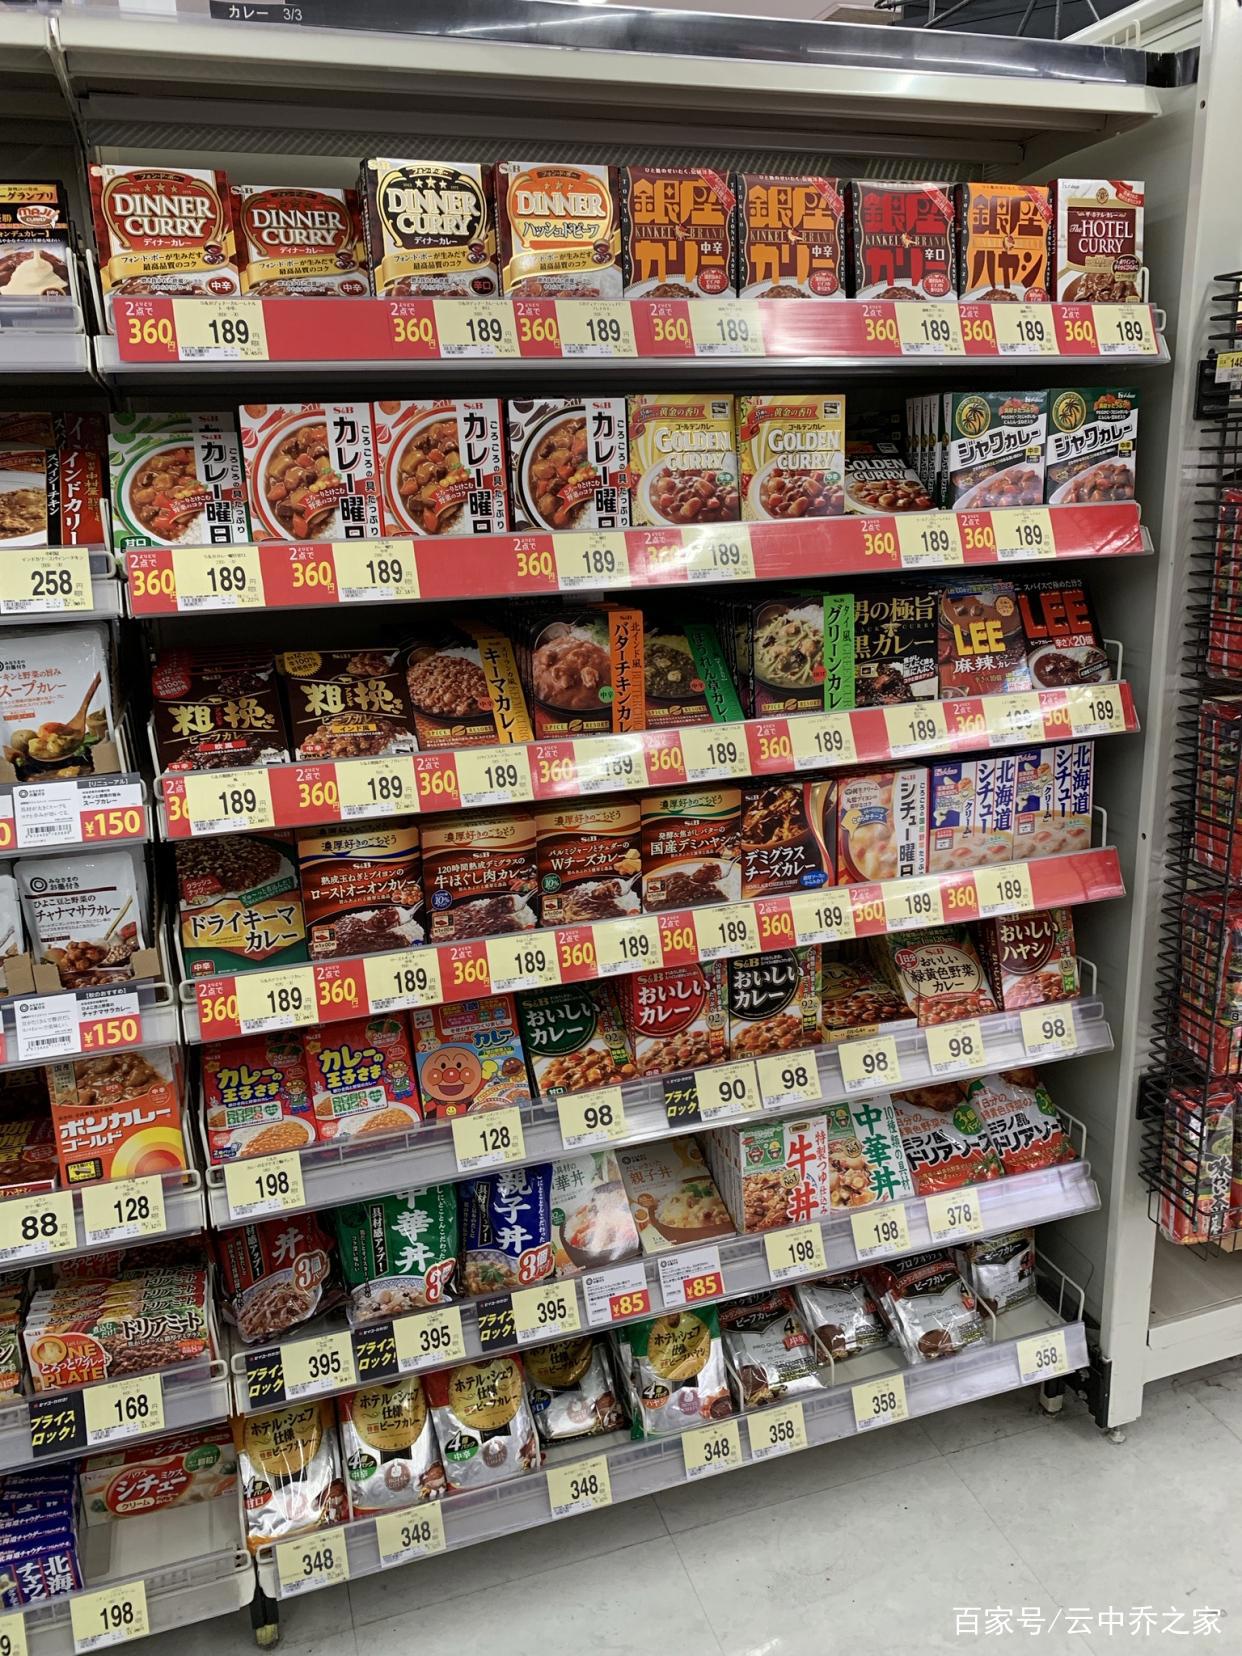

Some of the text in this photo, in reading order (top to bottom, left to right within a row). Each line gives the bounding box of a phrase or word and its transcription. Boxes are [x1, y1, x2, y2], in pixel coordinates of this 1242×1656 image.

[229, 5, 302, 21] カレー 3/3
[114, 193, 214, 218] DINNER
[387, 188, 480, 216] DINNER
[515, 191, 606, 216] DINNER
[632, 178, 725, 231] 銀座
[748, 186, 834, 230] 銀座
[124, 216, 206, 238] CURRY
[252, 210, 345, 230] DINNER
[396, 214, 471, 236] CURRY
[523, 221, 599, 239] ハッシュドビーフ
[1069, 220, 1133, 238] The HOTEL
[262, 229, 337, 246] CURRY
[635, 227, 725, 238] KINKEL BRAND
[750, 230, 834, 243] KINKEL BRAND
[700, 242, 722, 255] 中辛
[924, 248, 945, 261] 辛口
[1078, 238, 1124, 254] CURRY
[143, 260, 198, 270] 最高品質のコク
[635, 240, 725, 284] カリー
[750, 244, 834, 285] カリー
[972, 250, 1044, 289] ハヤシ
[211, 280, 232, 290] 中辛
[473, 280, 491, 290] 辛口
[129, 318, 174, 345] 360
[209, 320, 249, 344] 189
[587, 319, 620, 341] 189
[656, 320, 688, 340] 360
[717, 320, 748, 341] 189
[1017, 321, 1044, 341] 189
[1066, 321, 1092, 341] 360
[659, 407, 699, 418] 黄金の香り
[655, 428, 731, 453] GOLDEN
[767, 428, 840, 452] GOLDEN
[958, 428, 1041, 463] ジャワカレー
[1054, 424, 1133, 455] ジャワカレー
[665, 452, 726, 470] CURRY
[776, 452, 834, 470] CURRY
[48, 452, 60, 516] スパイシーチキン
[361, 425, 379, 537] ころころの具たっぷり
[490, 420, 505, 529] ころころの具たっぷり
[854, 470, 905, 482] CURRY
[62, 450, 82, 546] インドカリー
[966, 527, 993, 549] 360
[1016, 525, 1042, 545] 189
[713, 545, 739, 565] 189
[31, 570, 72, 595] 258
[207, 566, 245, 591] 189
[293, 561, 333, 588] 360
[367, 560, 402, 583] 189
[855, 598, 934, 622] 男の極旨
[1018, 590, 1093, 637] LEE
[631, 622, 642, 668] 北インド風
[954, 621, 1006, 655] LEE
[828, 606, 843, 708] グリーンカレ
[615, 624, 632, 733] バターチキンカレ
[300, 680, 403, 717] 粗挽き
[1089, 700, 1113, 720] 189
[168, 700, 276, 736] 粗挽き
[339, 724, 370, 732] インド風
[815, 731, 842, 752] 189
[485, 765, 517, 788] 189
[539, 760, 572, 783] 360
[1055, 749, 1071, 816] シチュー
[1072, 744, 1090, 815] 北海道
[368, 776, 402, 800] 189
[978, 763, 993, 834] シチュー
[994, 759, 1015, 832] 北海道
[444, 826, 516, 842] 濃厚好きのごちそう
[900, 782, 916, 876] シチュー曜日
[322, 835, 397, 852] 濃厚好きのごちそう
[437, 858, 525, 874] 120時間熟成デミグラスの
[745, 846, 805, 866] デミグラス
[321, 869, 404, 885] 熟成玉ねぎとブイヨンの
[745, 862, 816, 881] チーズカレー
[950, 887, 976, 906] 360
[997, 880, 1021, 900] 189
[191, 906, 294, 938] ドライキーマ
[815, 907, 842, 928] 189
[245, 930, 297, 951] カレー
[664, 928, 694, 951] 360
[719, 921, 746, 943] 189
[1001, 921, 1059, 942] おいしい
[515, 951, 545, 974] 189
[1003, 943, 1044, 960] ハヤシ
[734, 966, 804, 988] おいしい
[268, 987, 302, 1013] 189
[320, 978, 357, 1005] 360
[639, 978, 710, 1002] おいしい
[735, 990, 784, 1008] カレー
[527, 1003, 600, 1027] おいしい
[640, 1005, 690, 1025] カレー
[531, 1025, 584, 1045] カレー
[1042, 1019, 1065, 1039] 98
[949, 1037, 973, 1057] 98
[320, 1047, 384, 1072] カレーの
[863, 1052, 888, 1073] 98
[218, 1066, 283, 1088] カレーの
[326, 1065, 382, 1089] 王子さま
[782, 1067, 808, 1089] 98
[223, 1082, 280, 1103] 王子さま
[719, 1079, 745, 1101] 90
[60, 1108, 171, 1138] ボンカレー
[584, 1105, 612, 1128] 98
[62, 1131, 123, 1153] ゴールド
[480, 1127, 510, 1151] 128
[902, 1130, 946, 1150] ミラノ風
[852, 1104, 901, 1200] 中華丼
[906, 1134, 994, 1172] ドリアソース
[785, 1135, 820, 1220] 牛丼
[815, 1130, 828, 1214] 特製つゆ仕込み
[256, 1172, 289, 1198] 198
[114, 1196, 149, 1223] 128
[948, 1205, 971, 1226] 378
[22, 1213, 58, 1240] 88
[874, 1221, 898, 1243] 198
[789, 1240, 814, 1263] 198
[914, 1271, 952, 1292] ビーフカレー
[537, 1298, 566, 1323] 395
[735, 1309, 778, 1329] ビーフカレー
[122, 1311, 203, 1340] ドリアミート
[420, 1326, 450, 1351] 395
[309, 1351, 340, 1377] 395
[1036, 1347, 1057, 1368] 358
[115, 1395, 148, 1421] 168
[359, 1387, 419, 1408] ホテル・シェフ
[872, 1392, 896, 1414] 358
[251, 1409, 314, 1436] ホテル・シェフ
[770, 1421, 794, 1443] 358
[33, 1427, 76, 1445] ロック!
[704, 1438, 729, 1461] 348
[571, 1475, 598, 1499] 348
[119, 1500, 151, 1511] クリーム
[401, 1521, 431, 1547] 348
[303, 1549, 333, 1575] 348
[101, 1602, 133, 1629] 198
